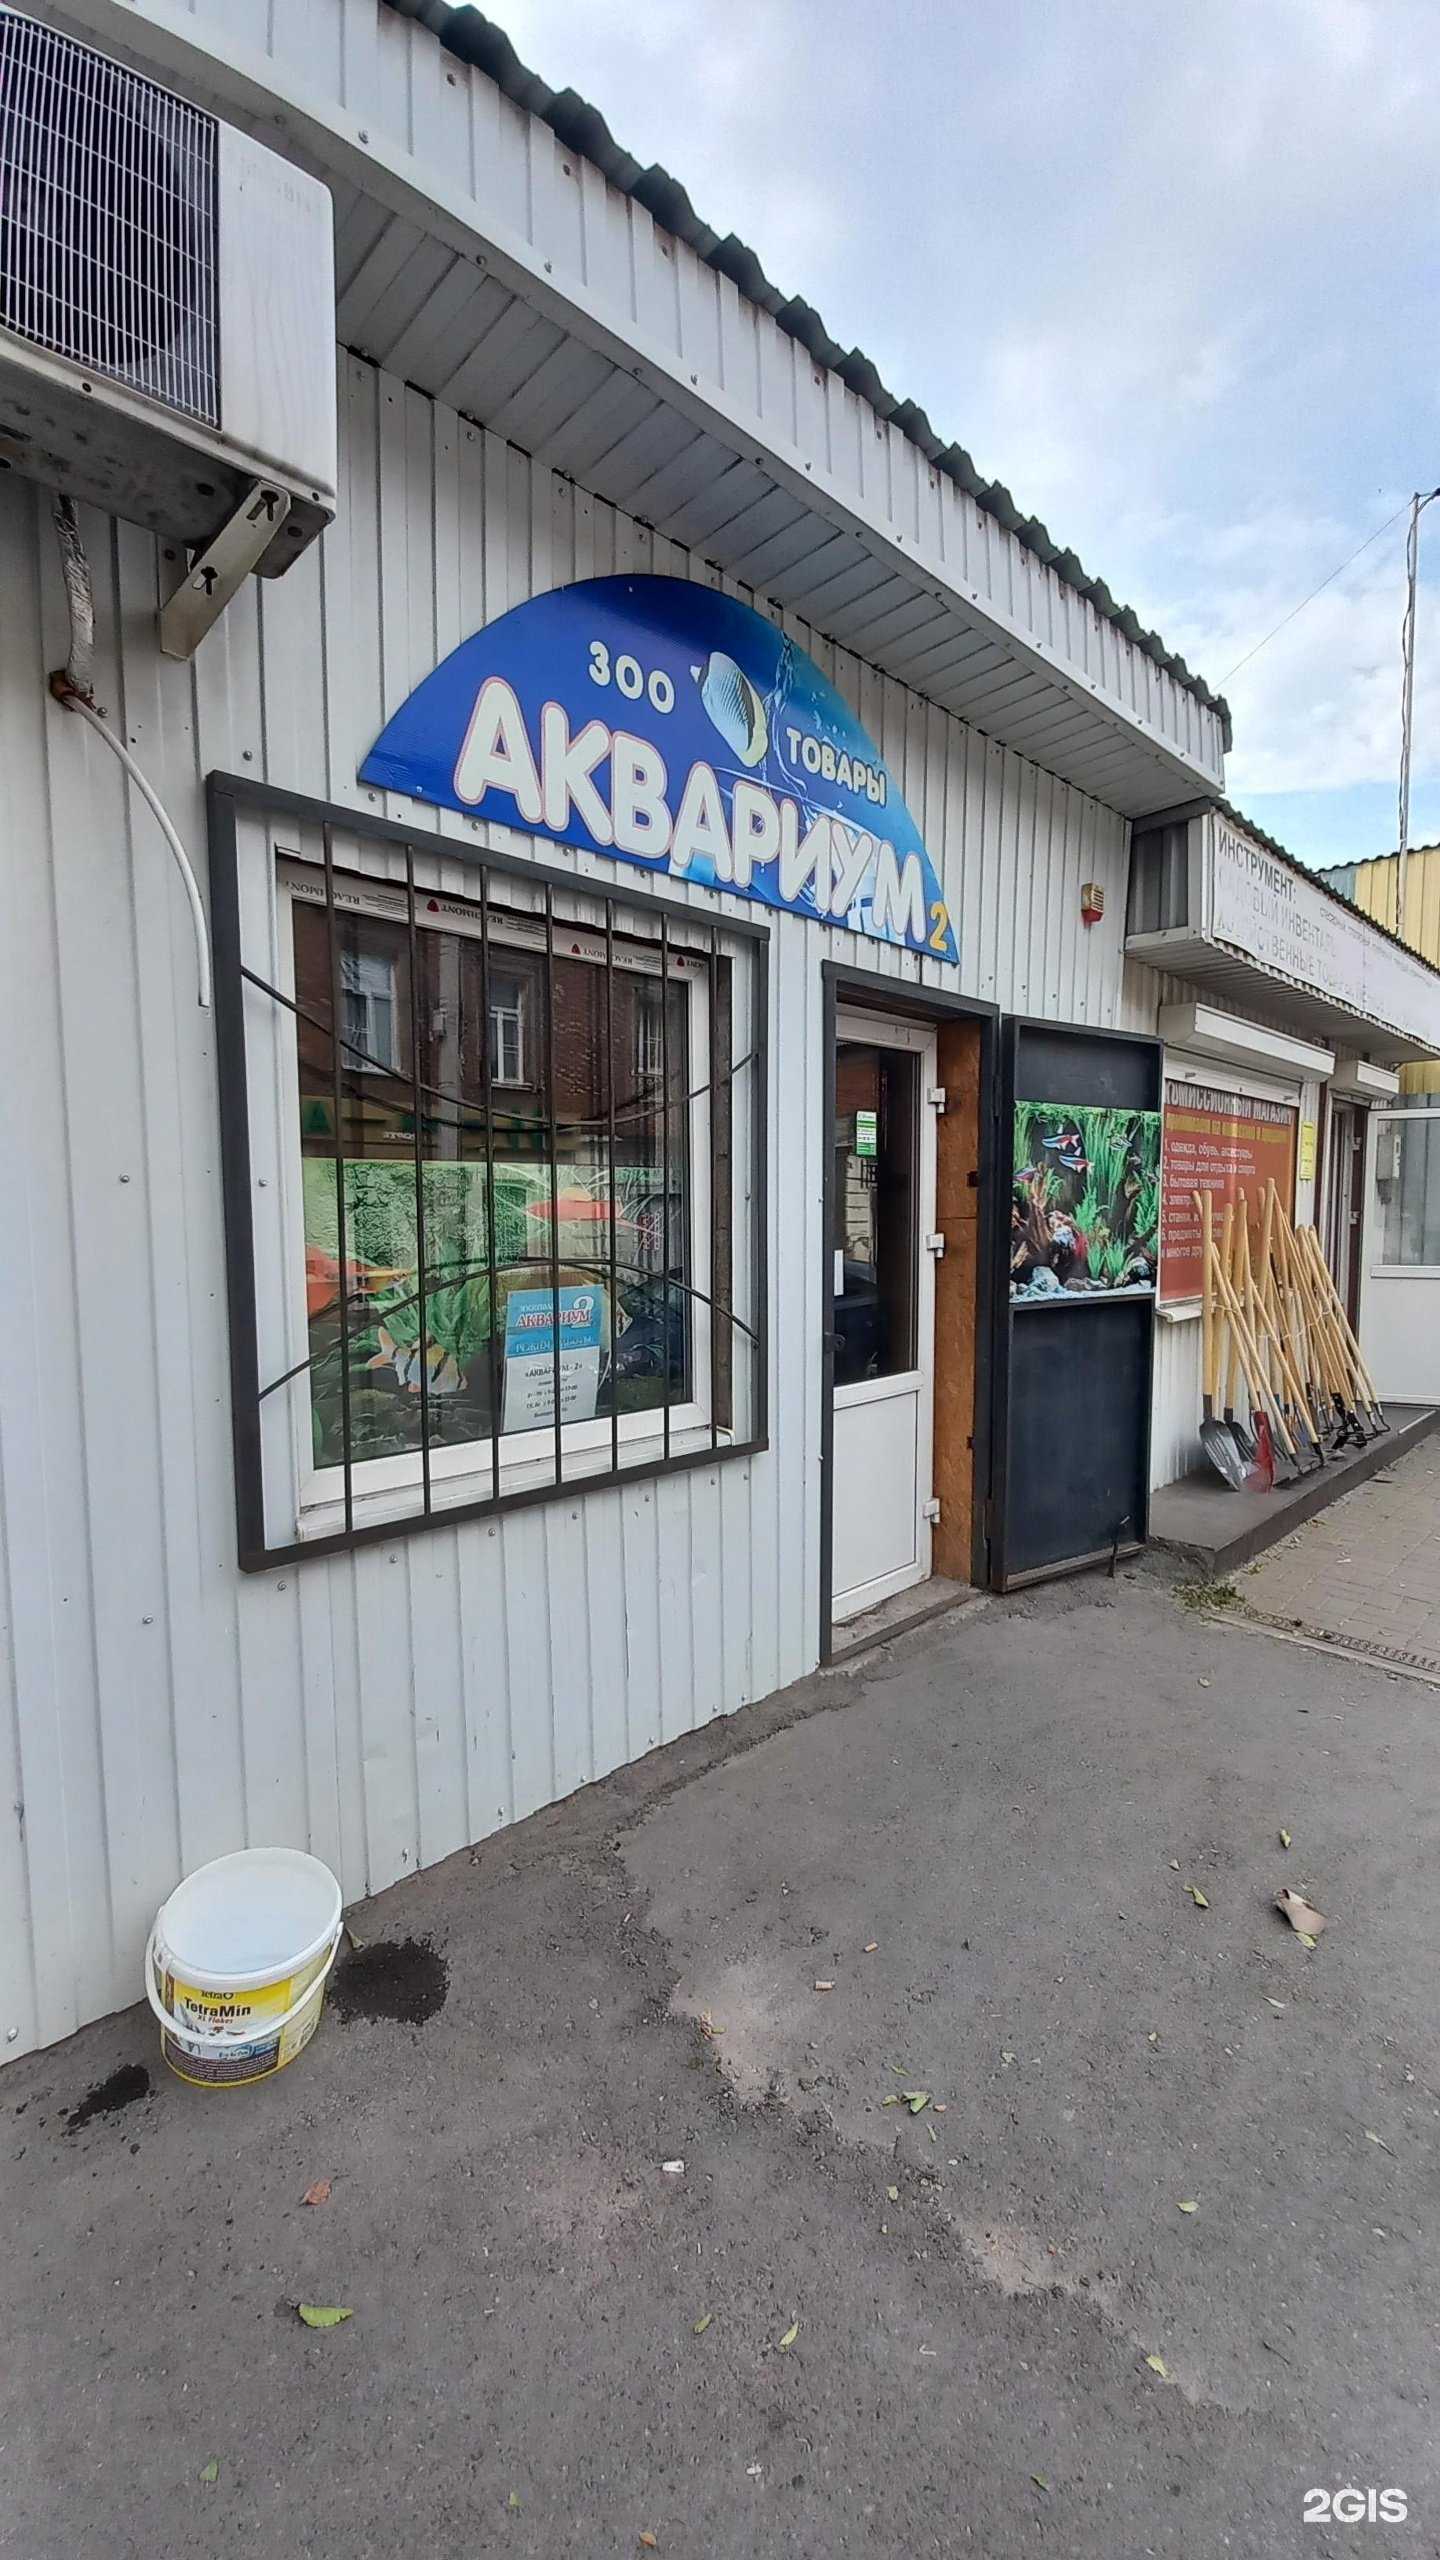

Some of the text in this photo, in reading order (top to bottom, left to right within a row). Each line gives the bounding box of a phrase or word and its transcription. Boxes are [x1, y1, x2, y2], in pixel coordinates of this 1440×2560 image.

[588, 641, 675, 714] ЗОО
[785, 726, 888, 808] ТОВАРЫ
[453, 675, 950, 953] АКВАРИУМ 2
[1218, 826, 1296, 904] ИНСТРУМЕНТ:
[184, 1996, 251, 2017] TetraMin
